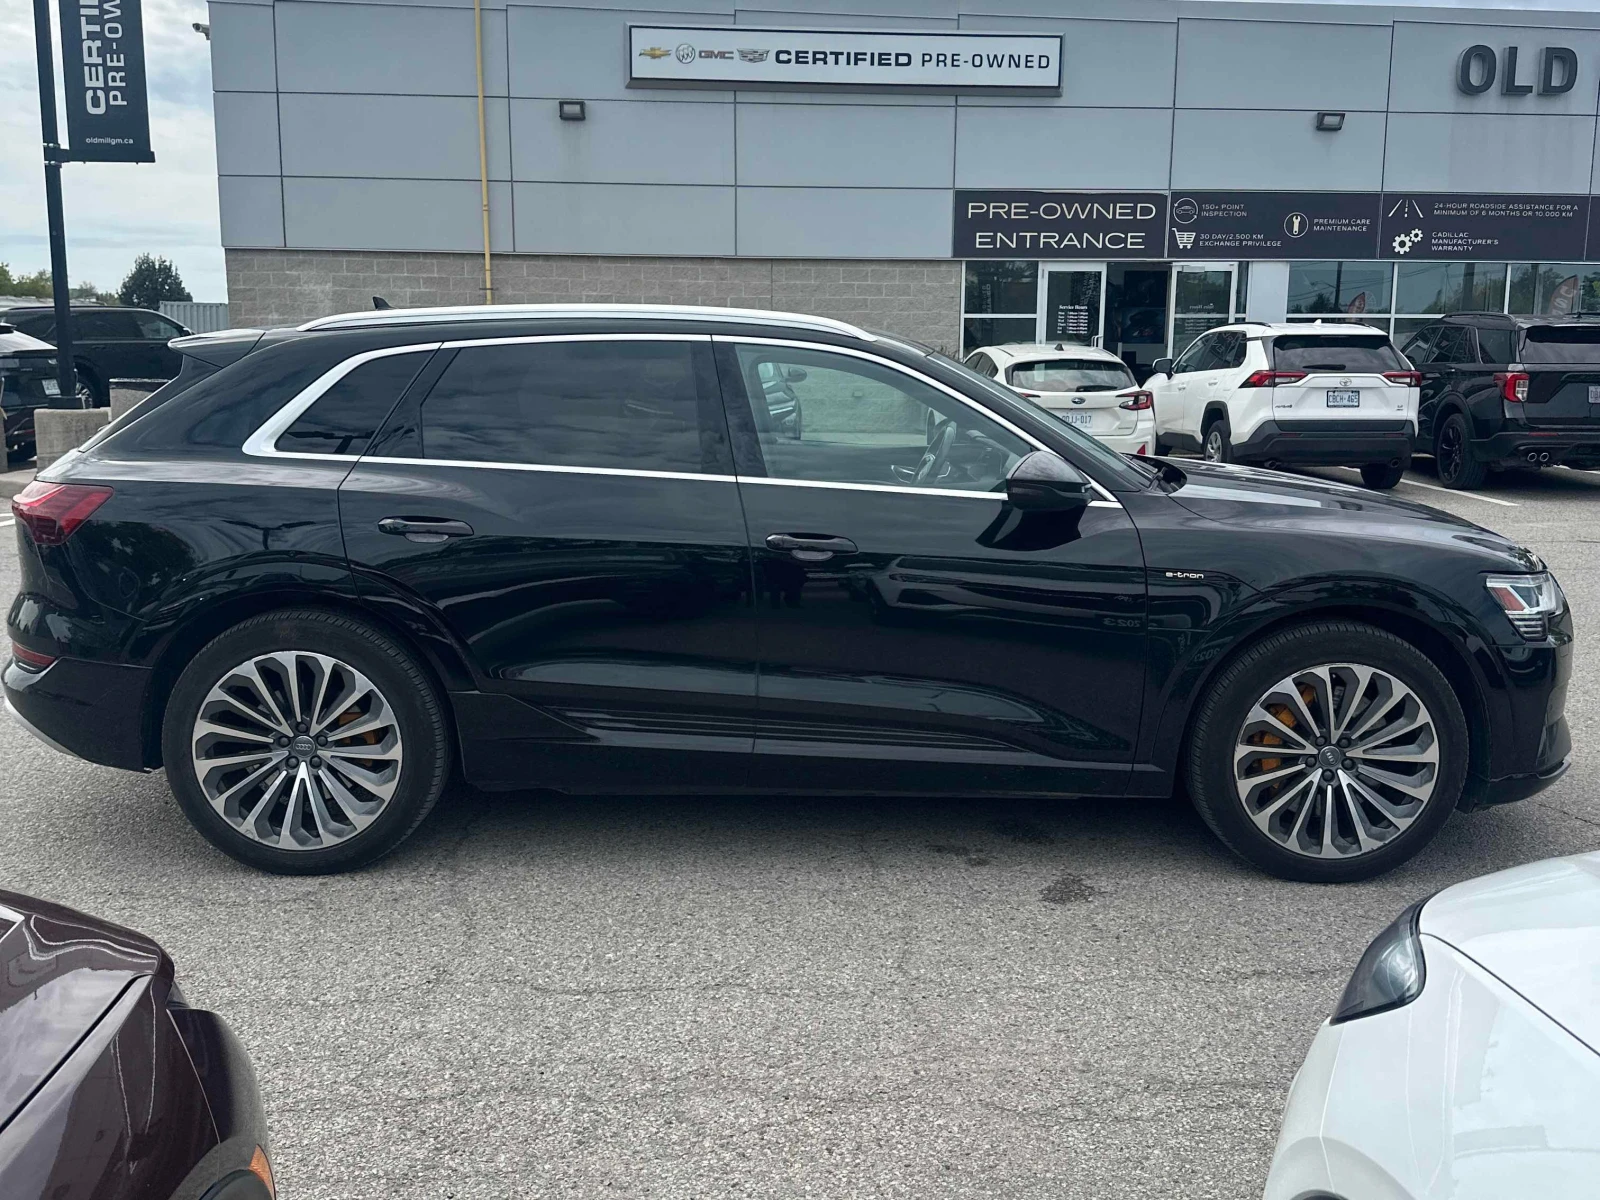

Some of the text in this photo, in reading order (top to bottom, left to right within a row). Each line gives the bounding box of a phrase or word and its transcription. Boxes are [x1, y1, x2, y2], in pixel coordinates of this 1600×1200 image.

[699, 49, 1050, 69] GMC CERTIFIED PRE-OWNED
[1456, 44, 1578, 96] OLD
[85, 137, 134, 146] oldmillgm.ca
[967, 202, 1156, 219] PRE-OWNED
[975, 232, 1146, 249] ENTRANCE
[1165, 571, 1204, 579] e-tron
